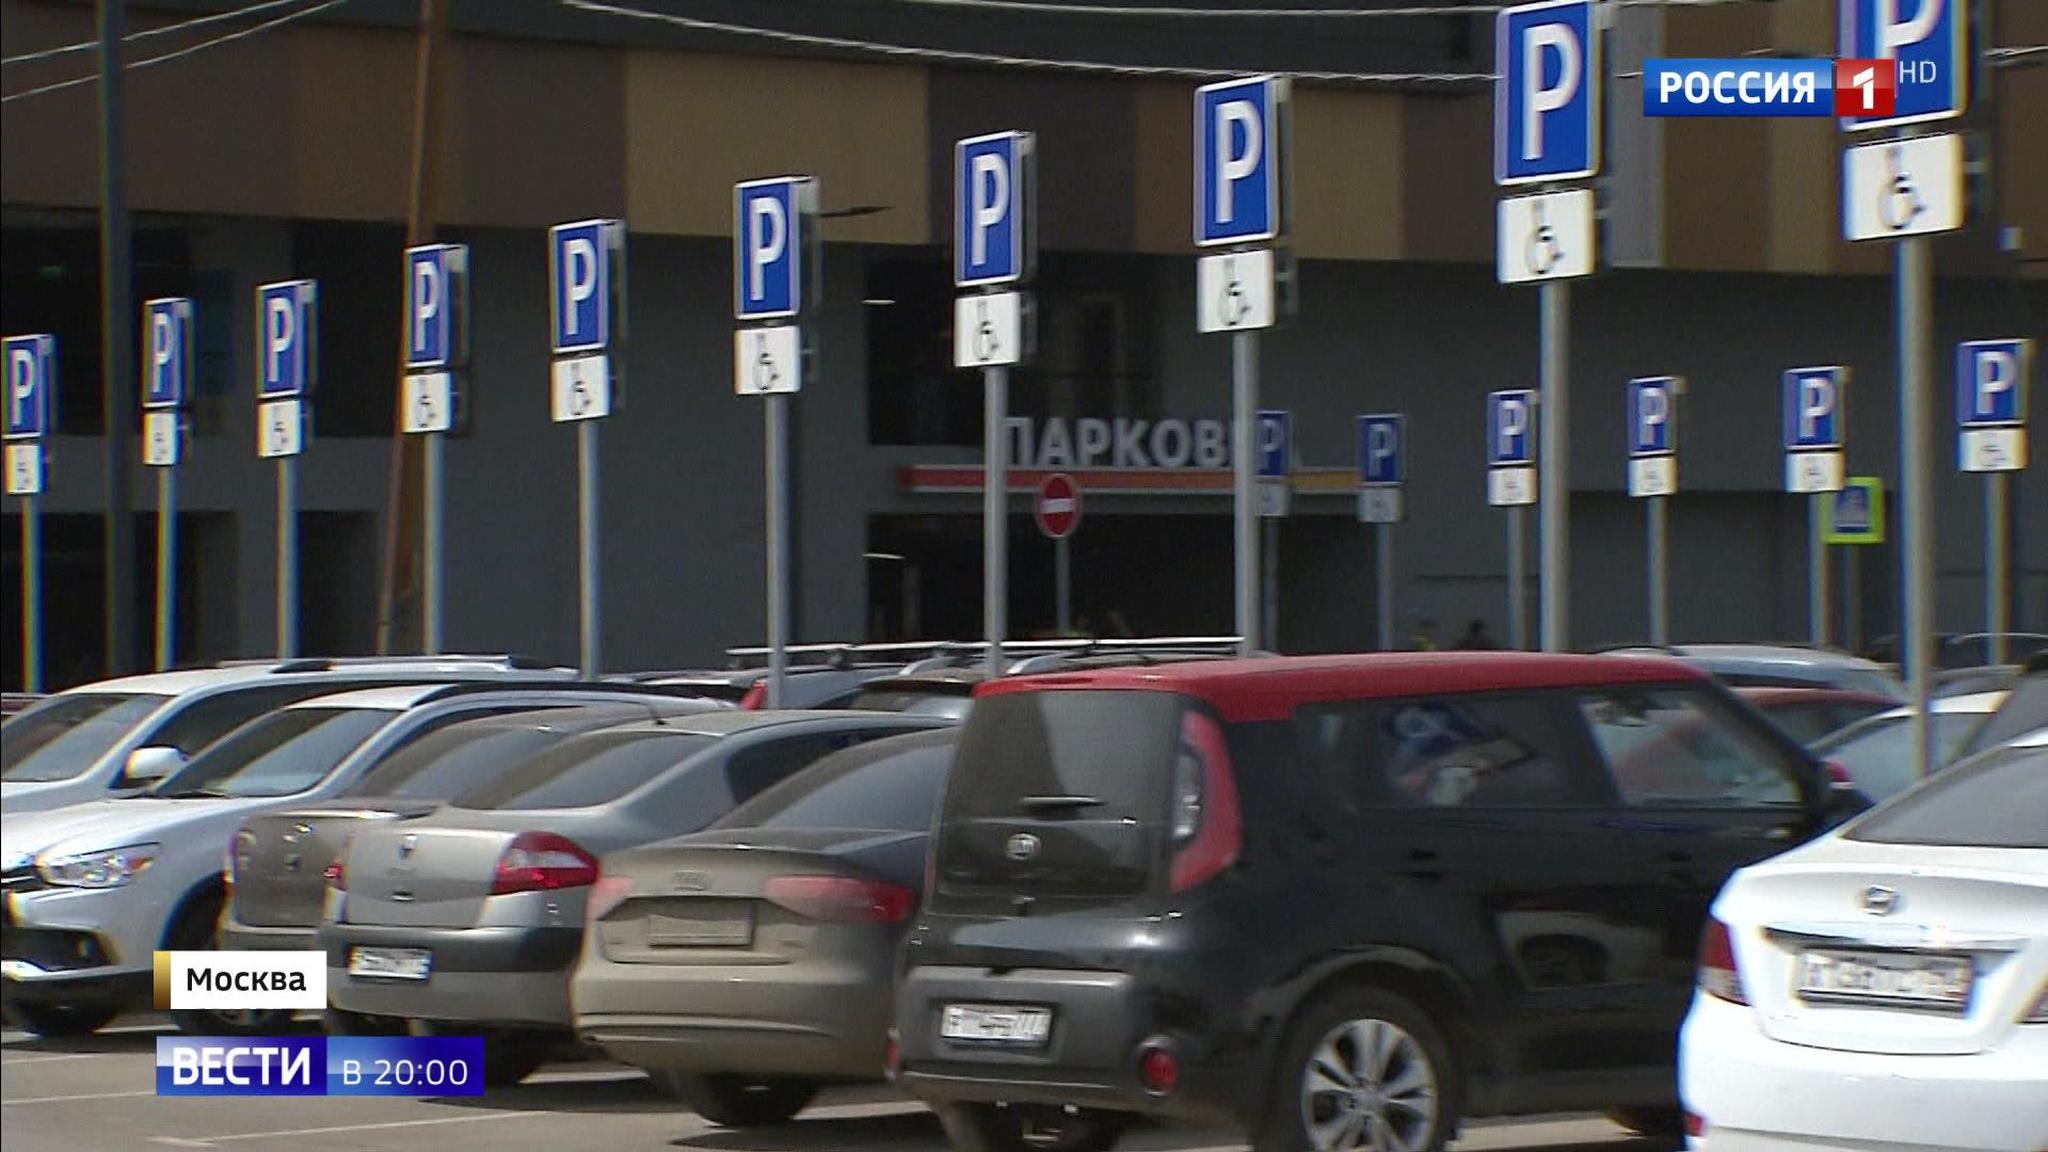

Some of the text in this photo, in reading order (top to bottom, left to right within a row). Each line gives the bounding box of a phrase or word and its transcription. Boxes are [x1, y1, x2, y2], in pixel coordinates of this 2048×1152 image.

[1523, 23, 1581, 160] P
[1214, 99, 1262, 223] P
[748, 196, 785, 300] P
[972, 152, 1009, 266] P
[413, 260, 438, 351] P
[564, 238, 597, 335] P
[152, 312, 173, 392] P
[265, 297, 293, 382] P
[10, 349, 34, 426] P
[1641, 388, 1667, 445] P
[1803, 378, 1834, 436] P
[1976, 351, 2015, 413] P
[1005, 417, 1303, 468] ПАРКОВ
[1370, 423, 1393, 475] P
[1500, 400, 1527, 455] P
